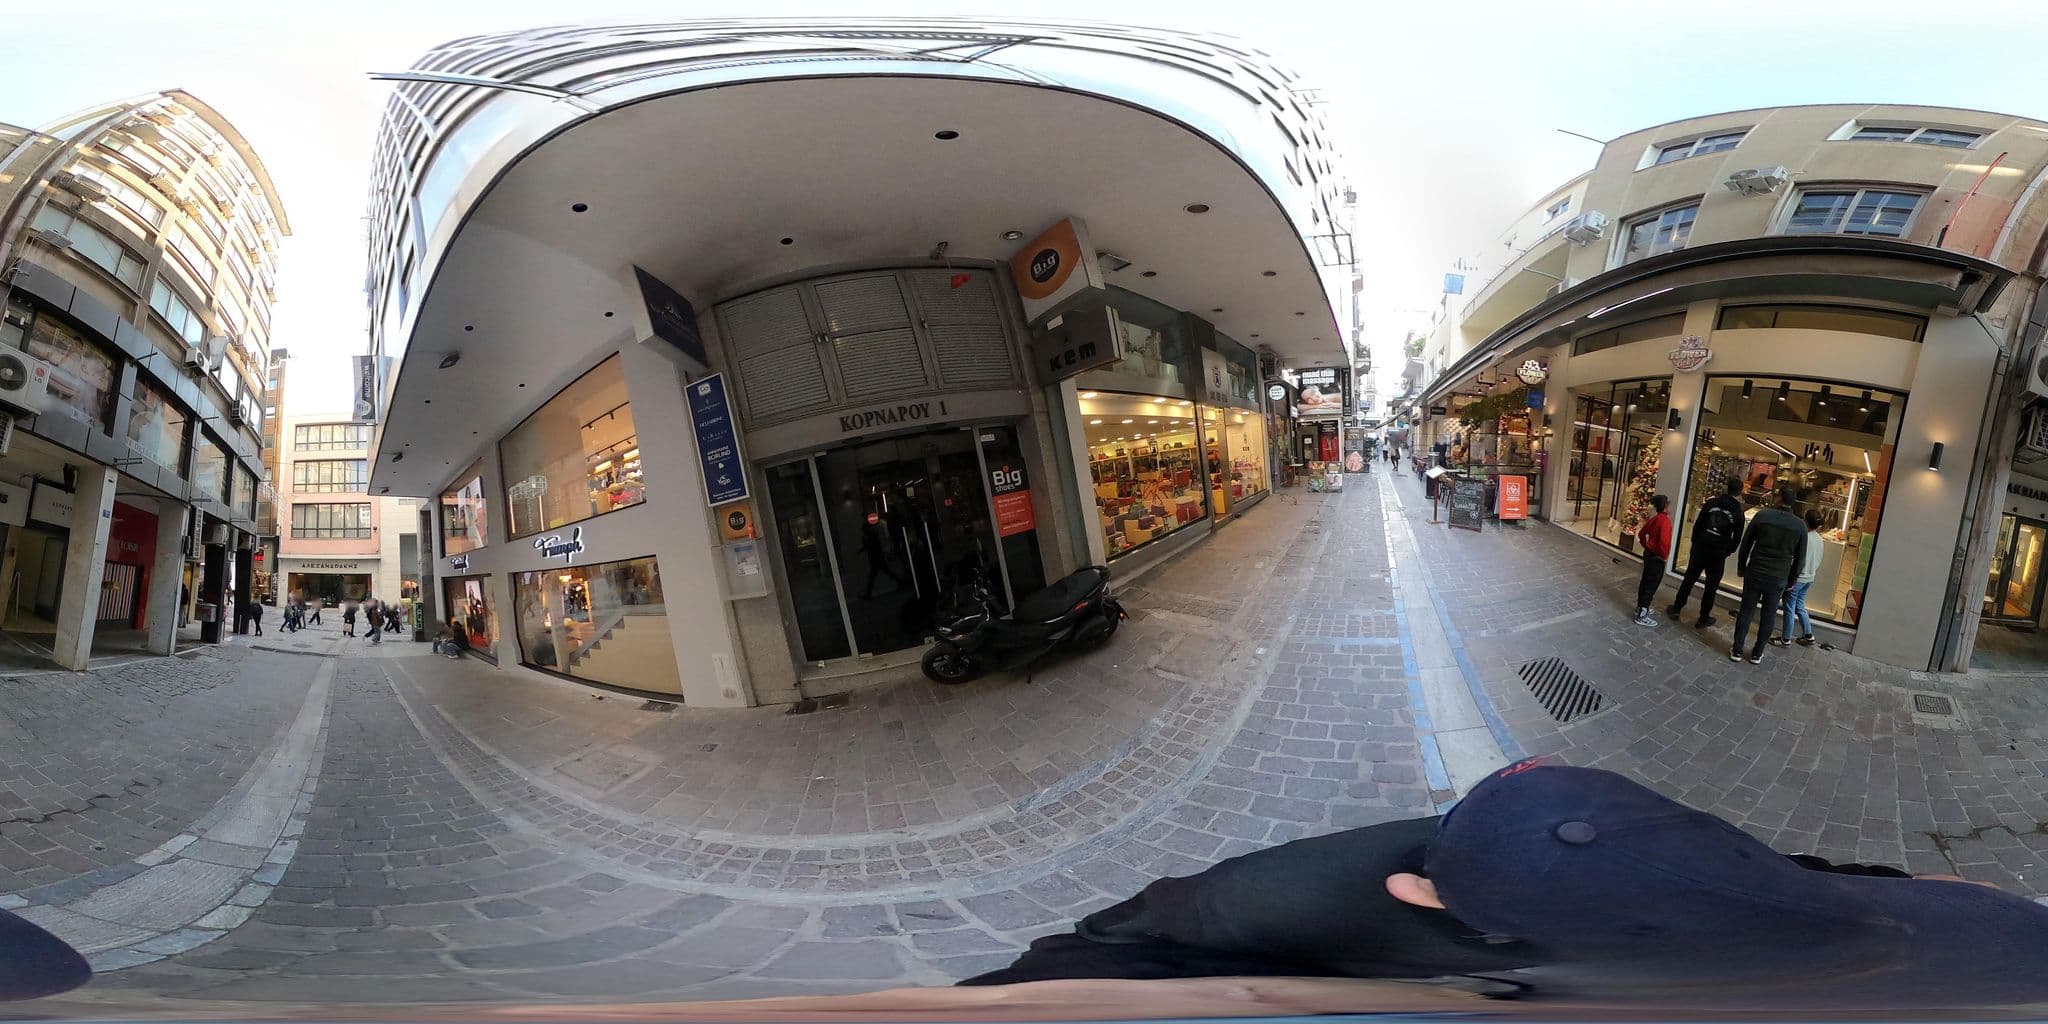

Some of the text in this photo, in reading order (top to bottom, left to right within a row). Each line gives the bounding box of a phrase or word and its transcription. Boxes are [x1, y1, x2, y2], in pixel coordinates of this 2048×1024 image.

[840, 400, 948, 432] ΚΟΡΝΑΡΟΥ 1
[992, 466, 1022, 486] Big
[534, 526, 584, 563] Triumph
